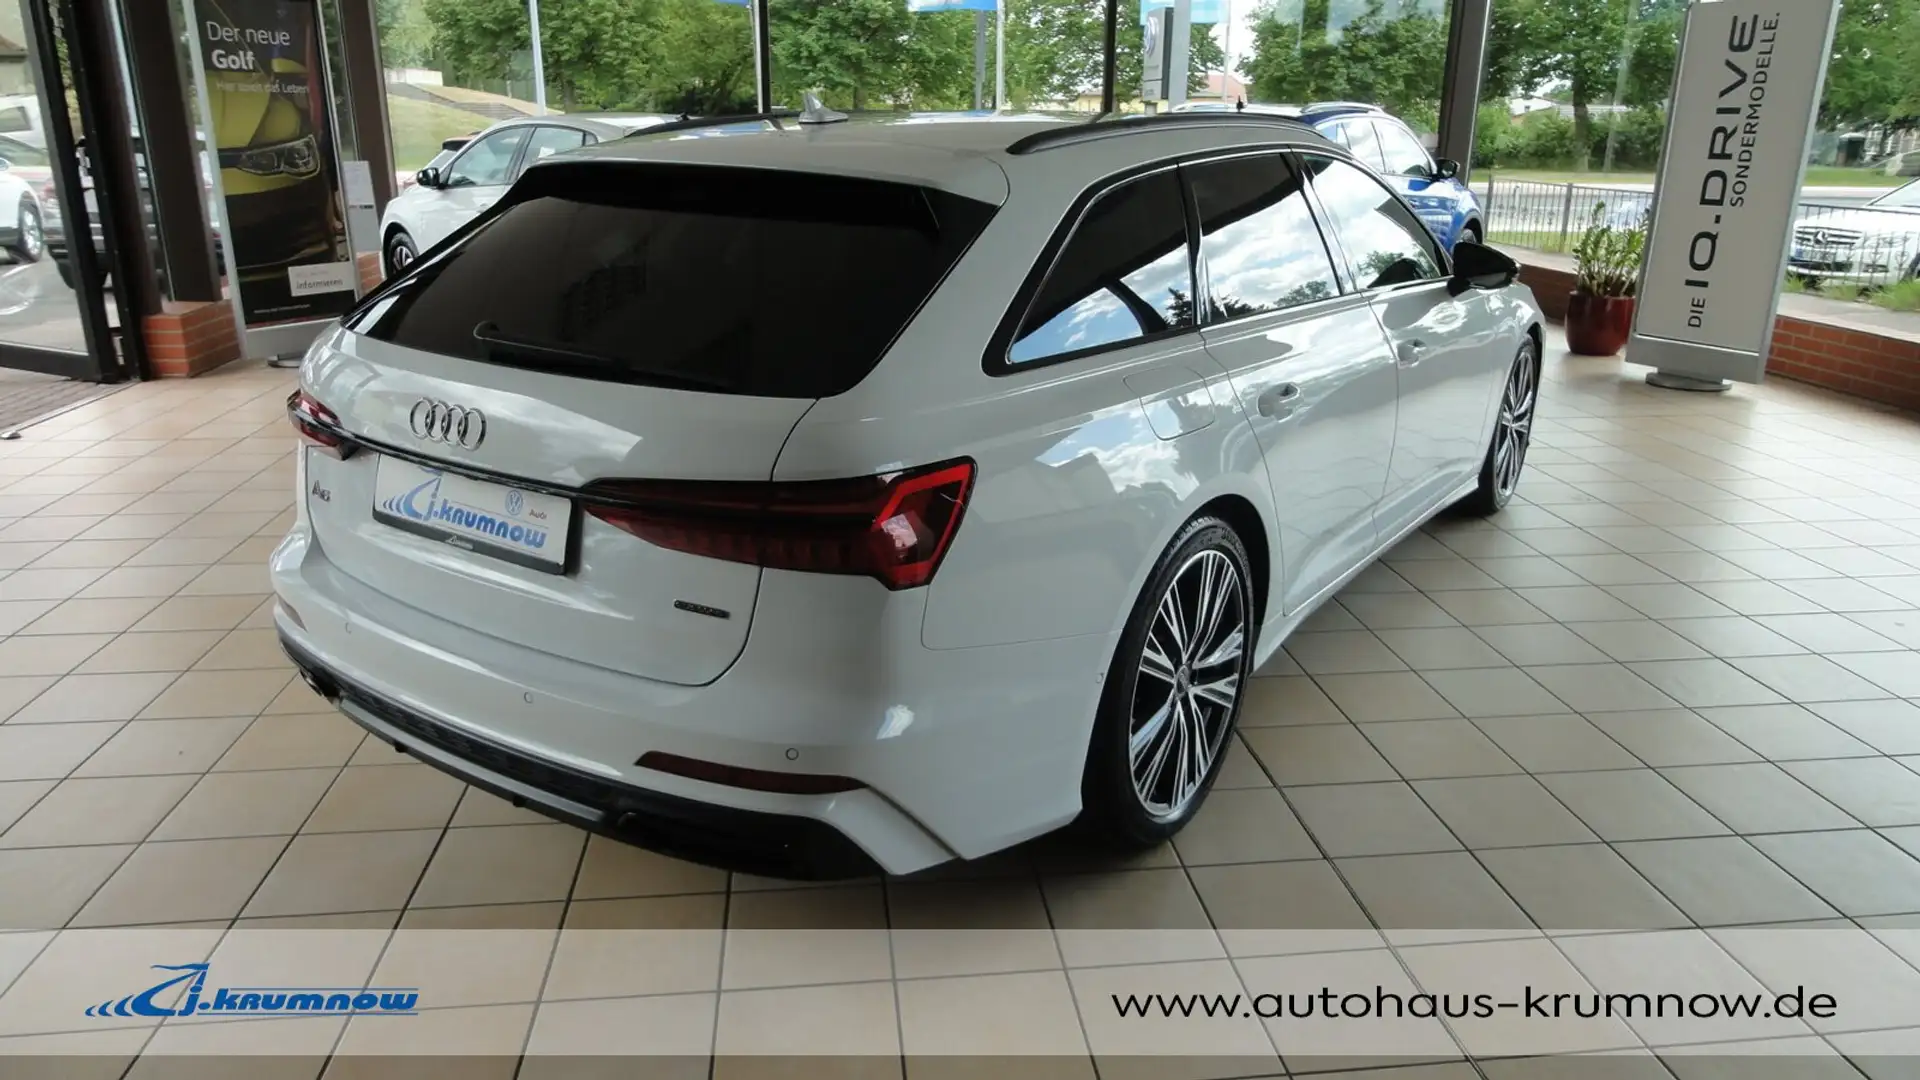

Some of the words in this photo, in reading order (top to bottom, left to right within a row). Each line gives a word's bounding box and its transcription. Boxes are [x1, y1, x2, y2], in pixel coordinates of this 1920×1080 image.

[206, 21, 239, 42] Der
[246, 28, 290, 46] neue
[211, 49, 255, 70] Golf
[1730, 12, 1780, 207] SONDERMODELLE.
[1684, 14, 1759, 288] IQ.DRIVE
[1687, 297, 1706, 328] DIE
